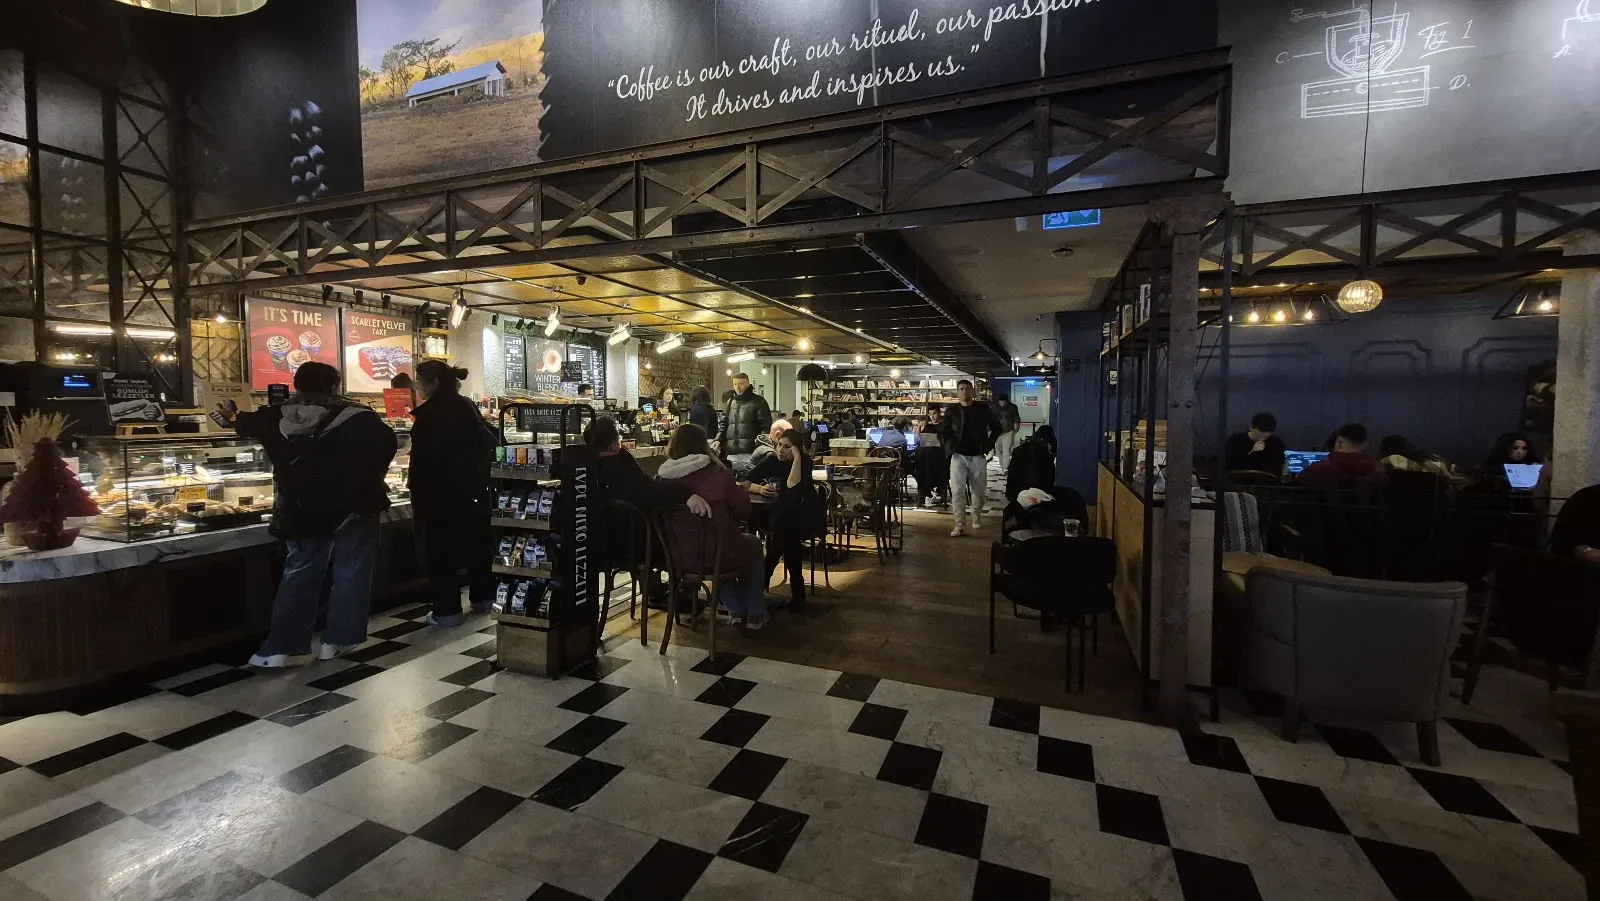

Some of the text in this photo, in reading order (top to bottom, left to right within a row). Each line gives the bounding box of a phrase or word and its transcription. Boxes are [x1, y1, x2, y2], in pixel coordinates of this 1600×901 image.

[676, 68, 694, 87] is
[699, 60, 733, 82] our
[738, 37, 796, 75] craft,
[805, 37, 845, 61] our
[935, 9, 981, 34] our
[685, 93, 707, 122] It
[711, 88, 774, 116] drives
[779, 70, 822, 104] and
[826, 61, 922, 106] inspires
[264, 306, 322, 327] IT'S TIME
[351, 316, 406, 332] SCARLET VELVET
[372, 328, 388, 337] CAKE
[535, 373, 561, 384] WINTER
[537, 382, 560, 391] BLEND
